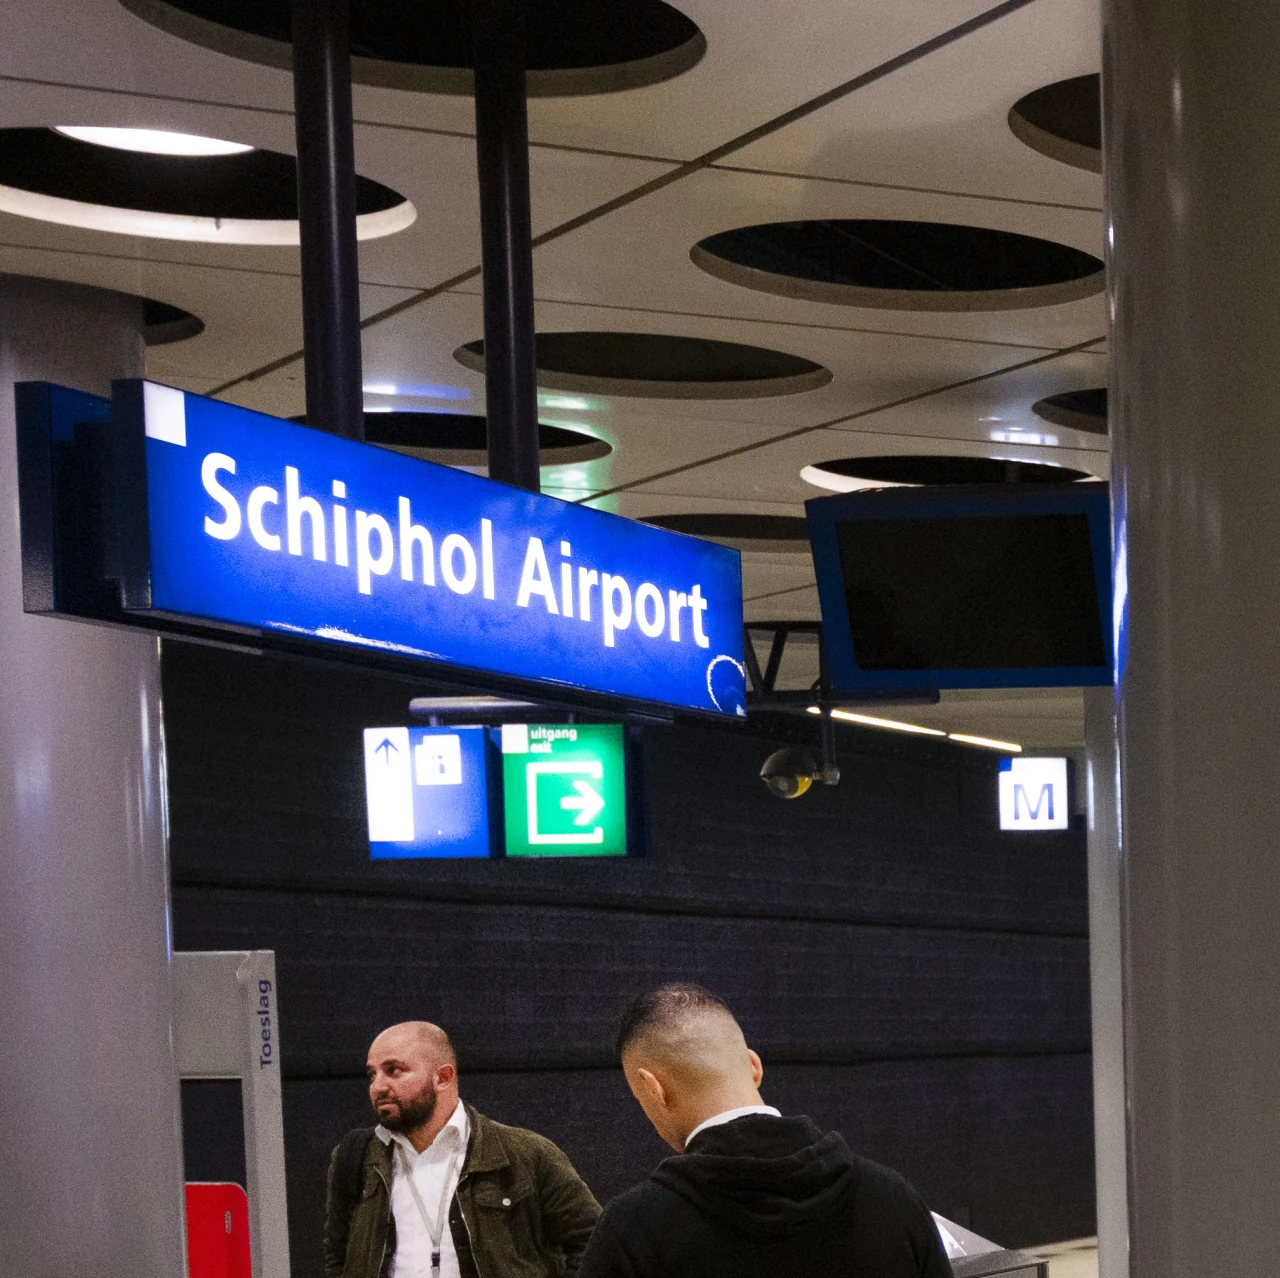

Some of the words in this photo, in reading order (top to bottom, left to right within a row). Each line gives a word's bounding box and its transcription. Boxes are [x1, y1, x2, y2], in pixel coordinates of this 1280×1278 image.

[201, 452, 495, 601] Schiphol
[516, 536, 710, 649] Airport
[530, 726, 577, 742] uitgang
[1013, 783, 1055, 821] M
[256, 979, 272, 1070] Toeslag
